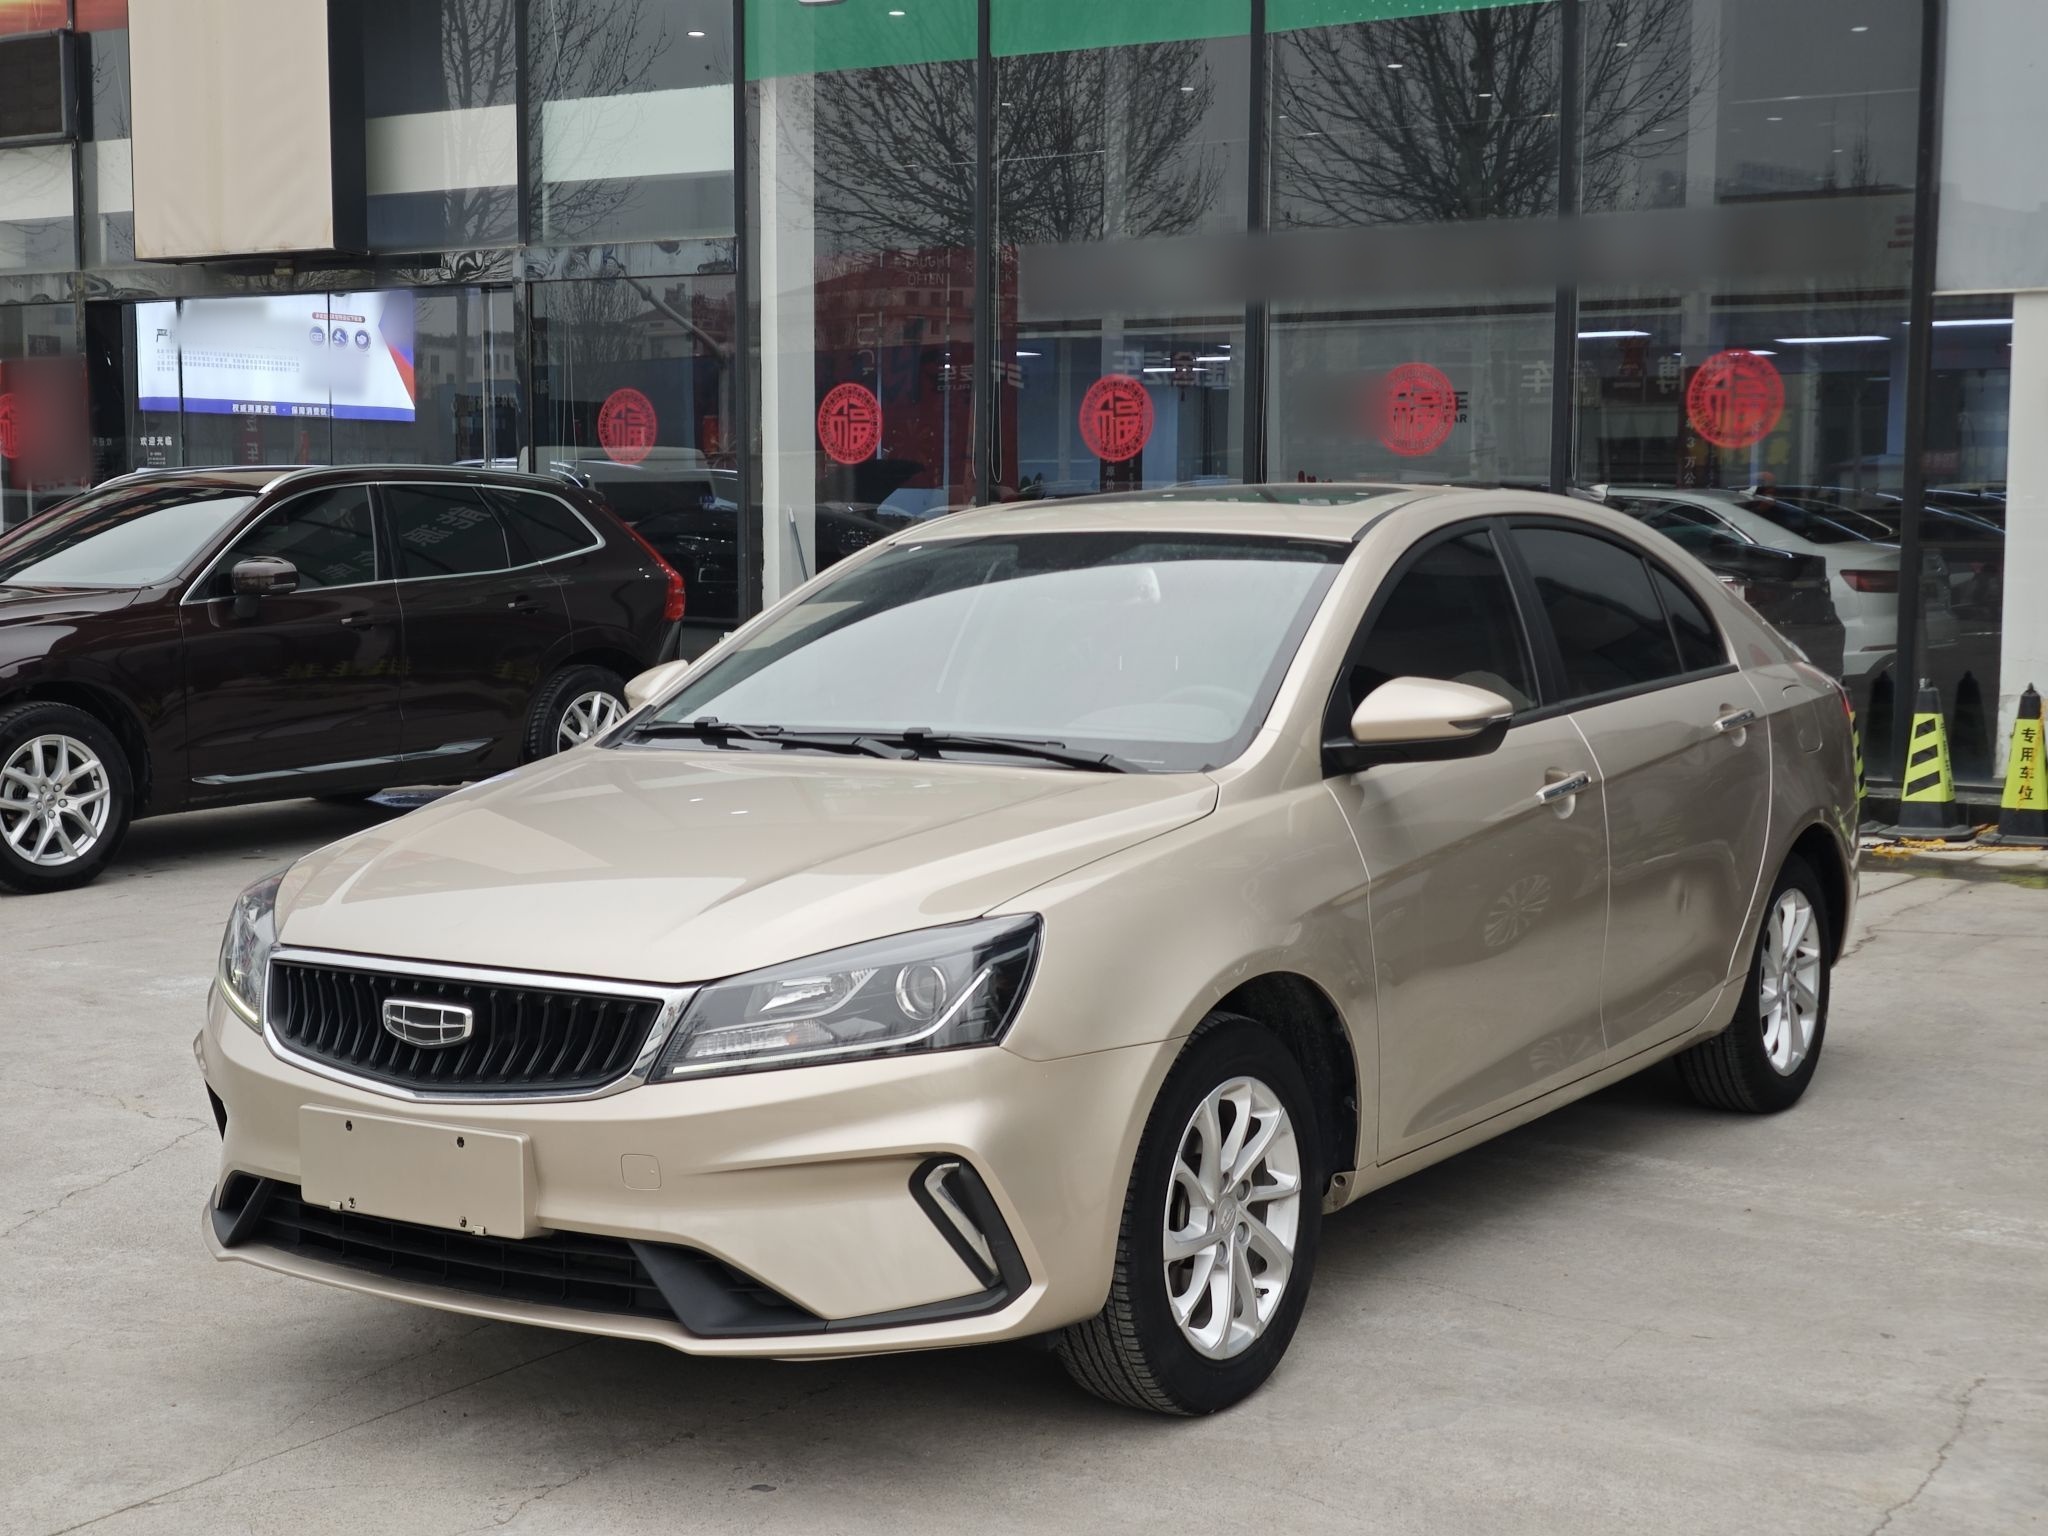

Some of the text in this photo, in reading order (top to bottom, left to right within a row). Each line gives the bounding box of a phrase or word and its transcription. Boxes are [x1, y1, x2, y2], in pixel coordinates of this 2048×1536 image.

[140, 435, 174, 447] 欢迎光临
[2018, 727, 2037, 801] 专用车位
